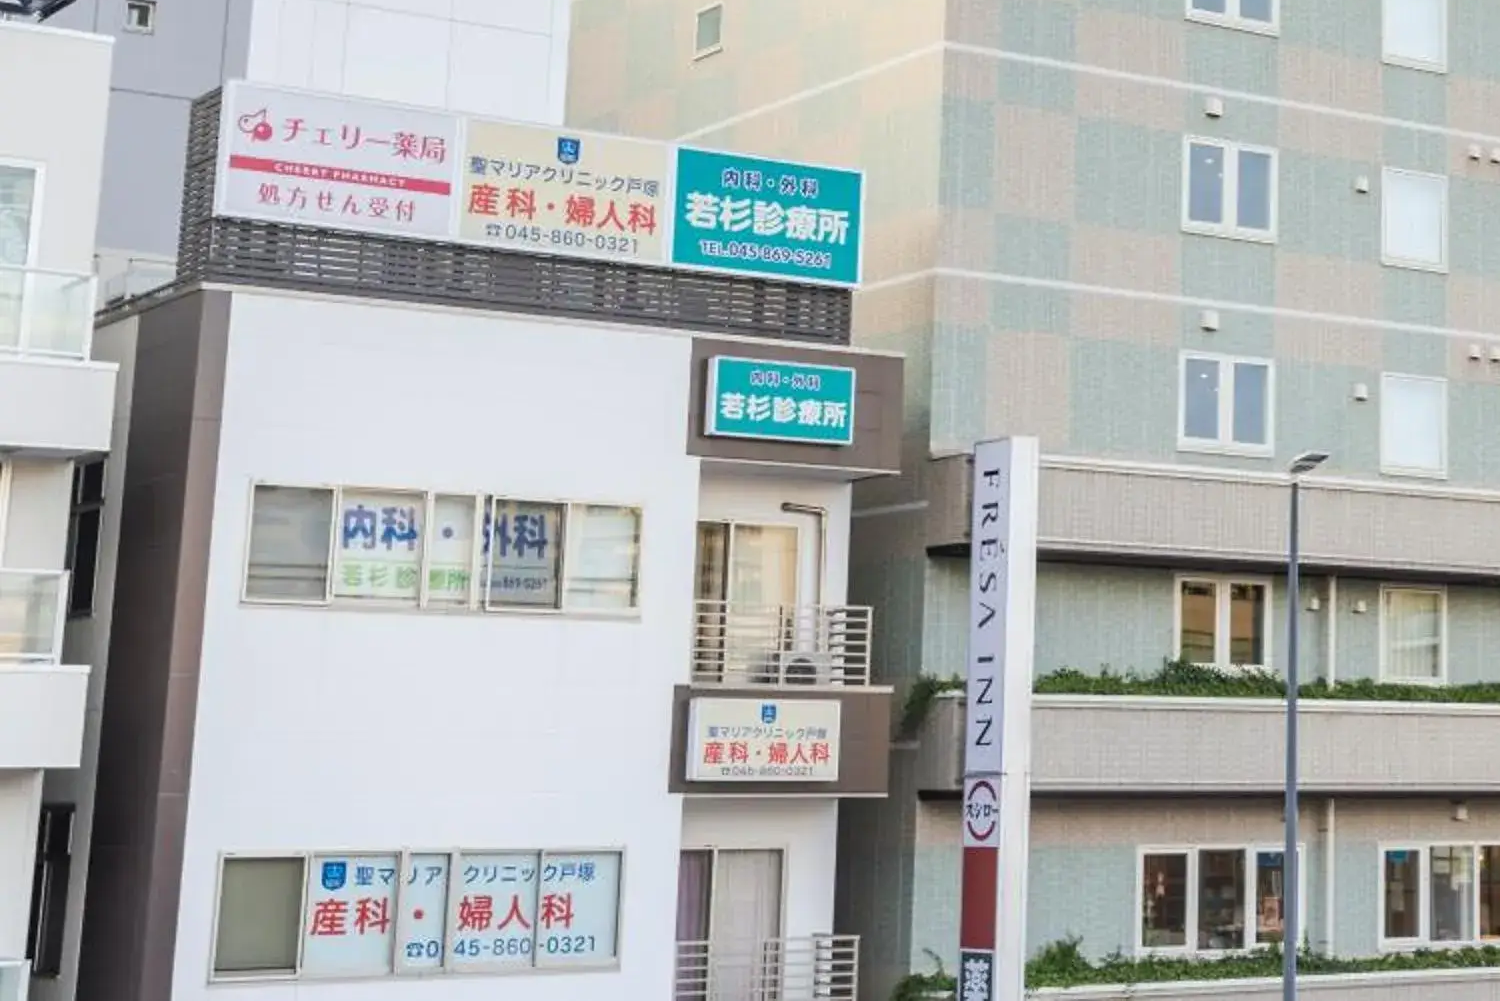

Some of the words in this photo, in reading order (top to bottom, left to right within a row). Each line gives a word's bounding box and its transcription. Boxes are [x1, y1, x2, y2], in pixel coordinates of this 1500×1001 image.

[282, 117, 446, 164] チェリー薬局
[332, 169, 406, 188] PHARMACY
[470, 155, 660, 198] 聖マリアクリニック戸塚
[721, 168, 820, 199] 内科・外科
[257, 181, 416, 223] 処方せん受付
[467, 182, 657, 236] 産科・婦人科
[684, 190, 850, 246] 若杉診療所
[505, 223, 639, 254] 045-860-0321
[719, 391, 848, 429] 若杉診療所
[977, 468, 1005, 629] FRÉSA
[974, 655, 994, 746] INN
[703, 740, 832, 766] 産科・婦人科
[965, 803, 1000, 820] スシロー
